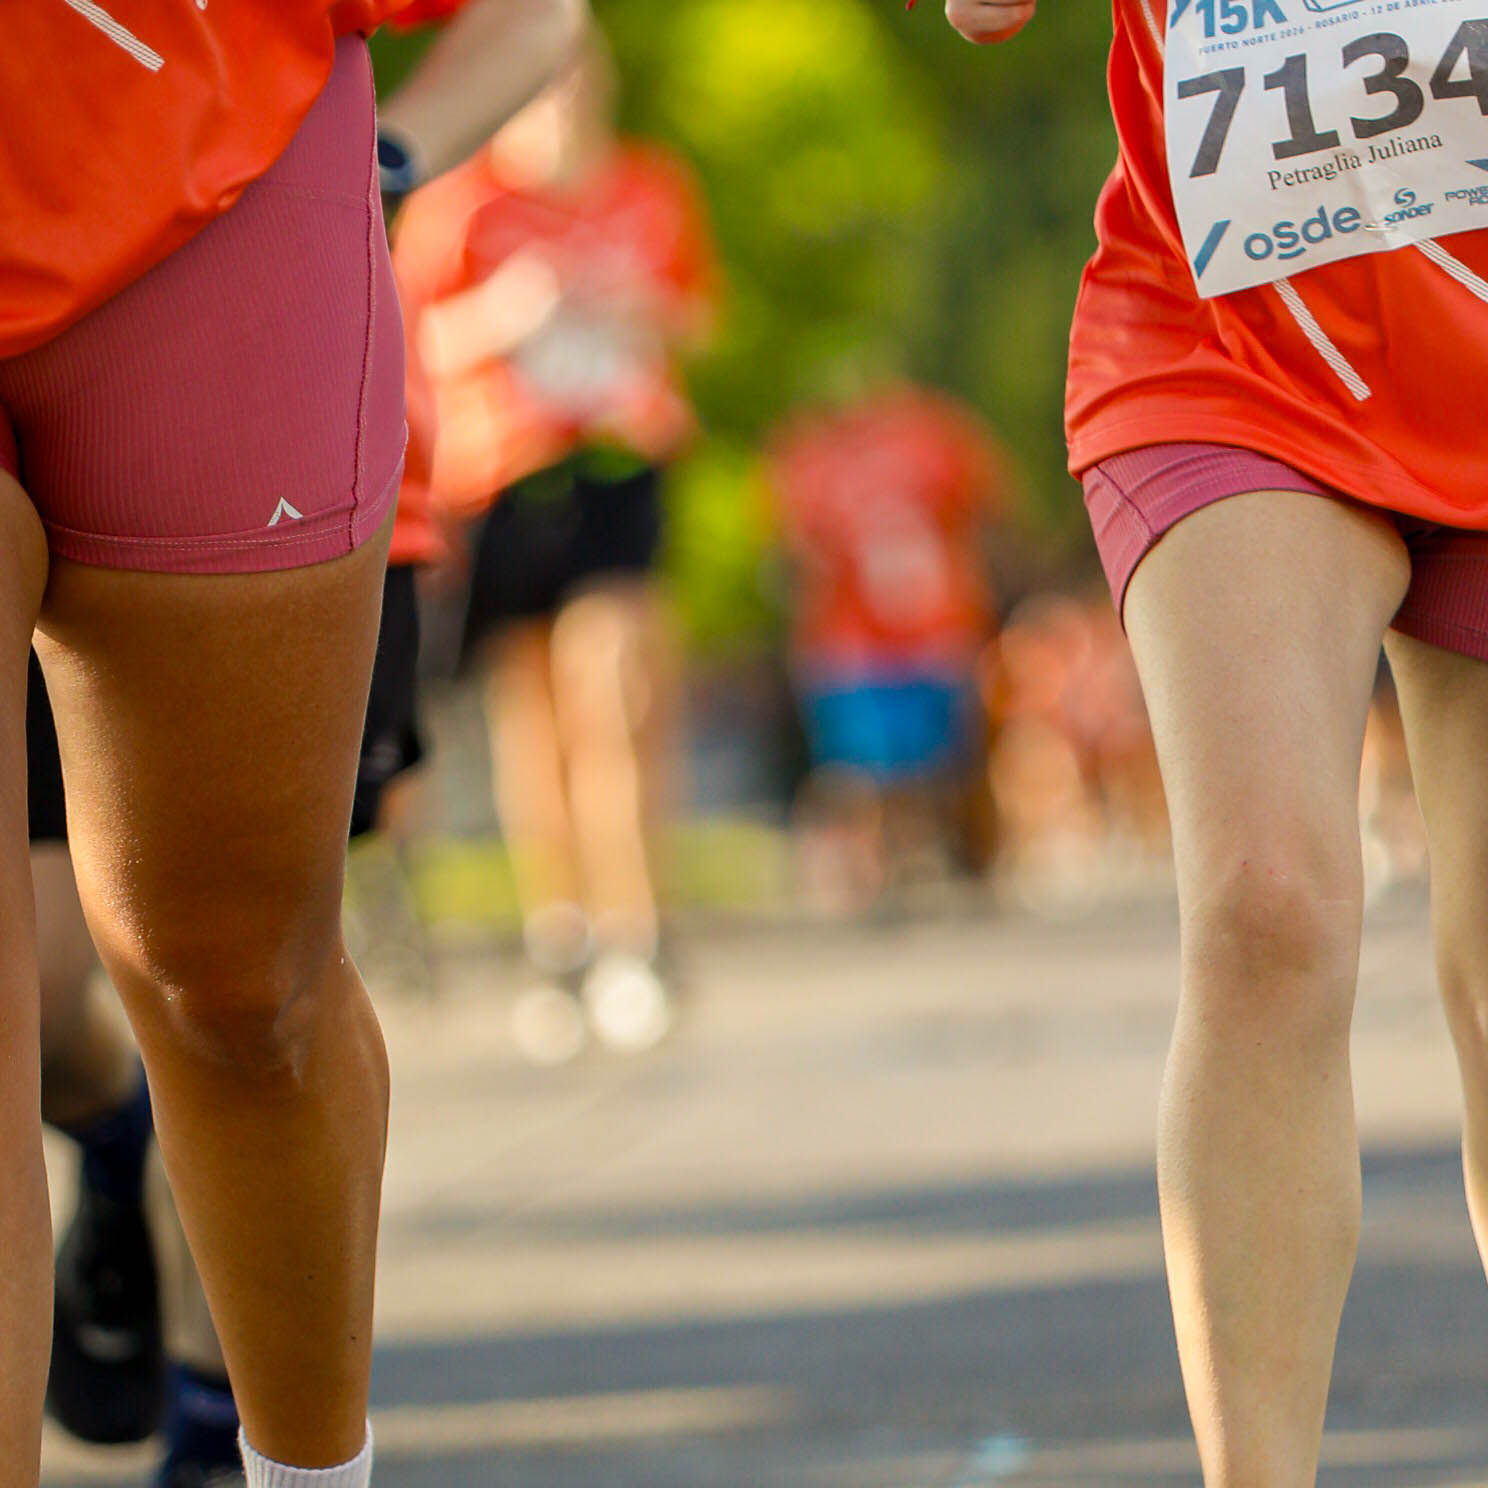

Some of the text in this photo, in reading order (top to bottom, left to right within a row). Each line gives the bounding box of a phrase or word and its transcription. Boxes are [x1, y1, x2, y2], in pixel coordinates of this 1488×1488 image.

[1241, 32, 1276, 47] NORTE
[1314, 10, 1360, 28] ROSARIO
[1386, 1, 1401, 12] DE
[1266, 133, 1444, 190] Petraglia Juliana
[1244, 204, 1362, 261] osde
